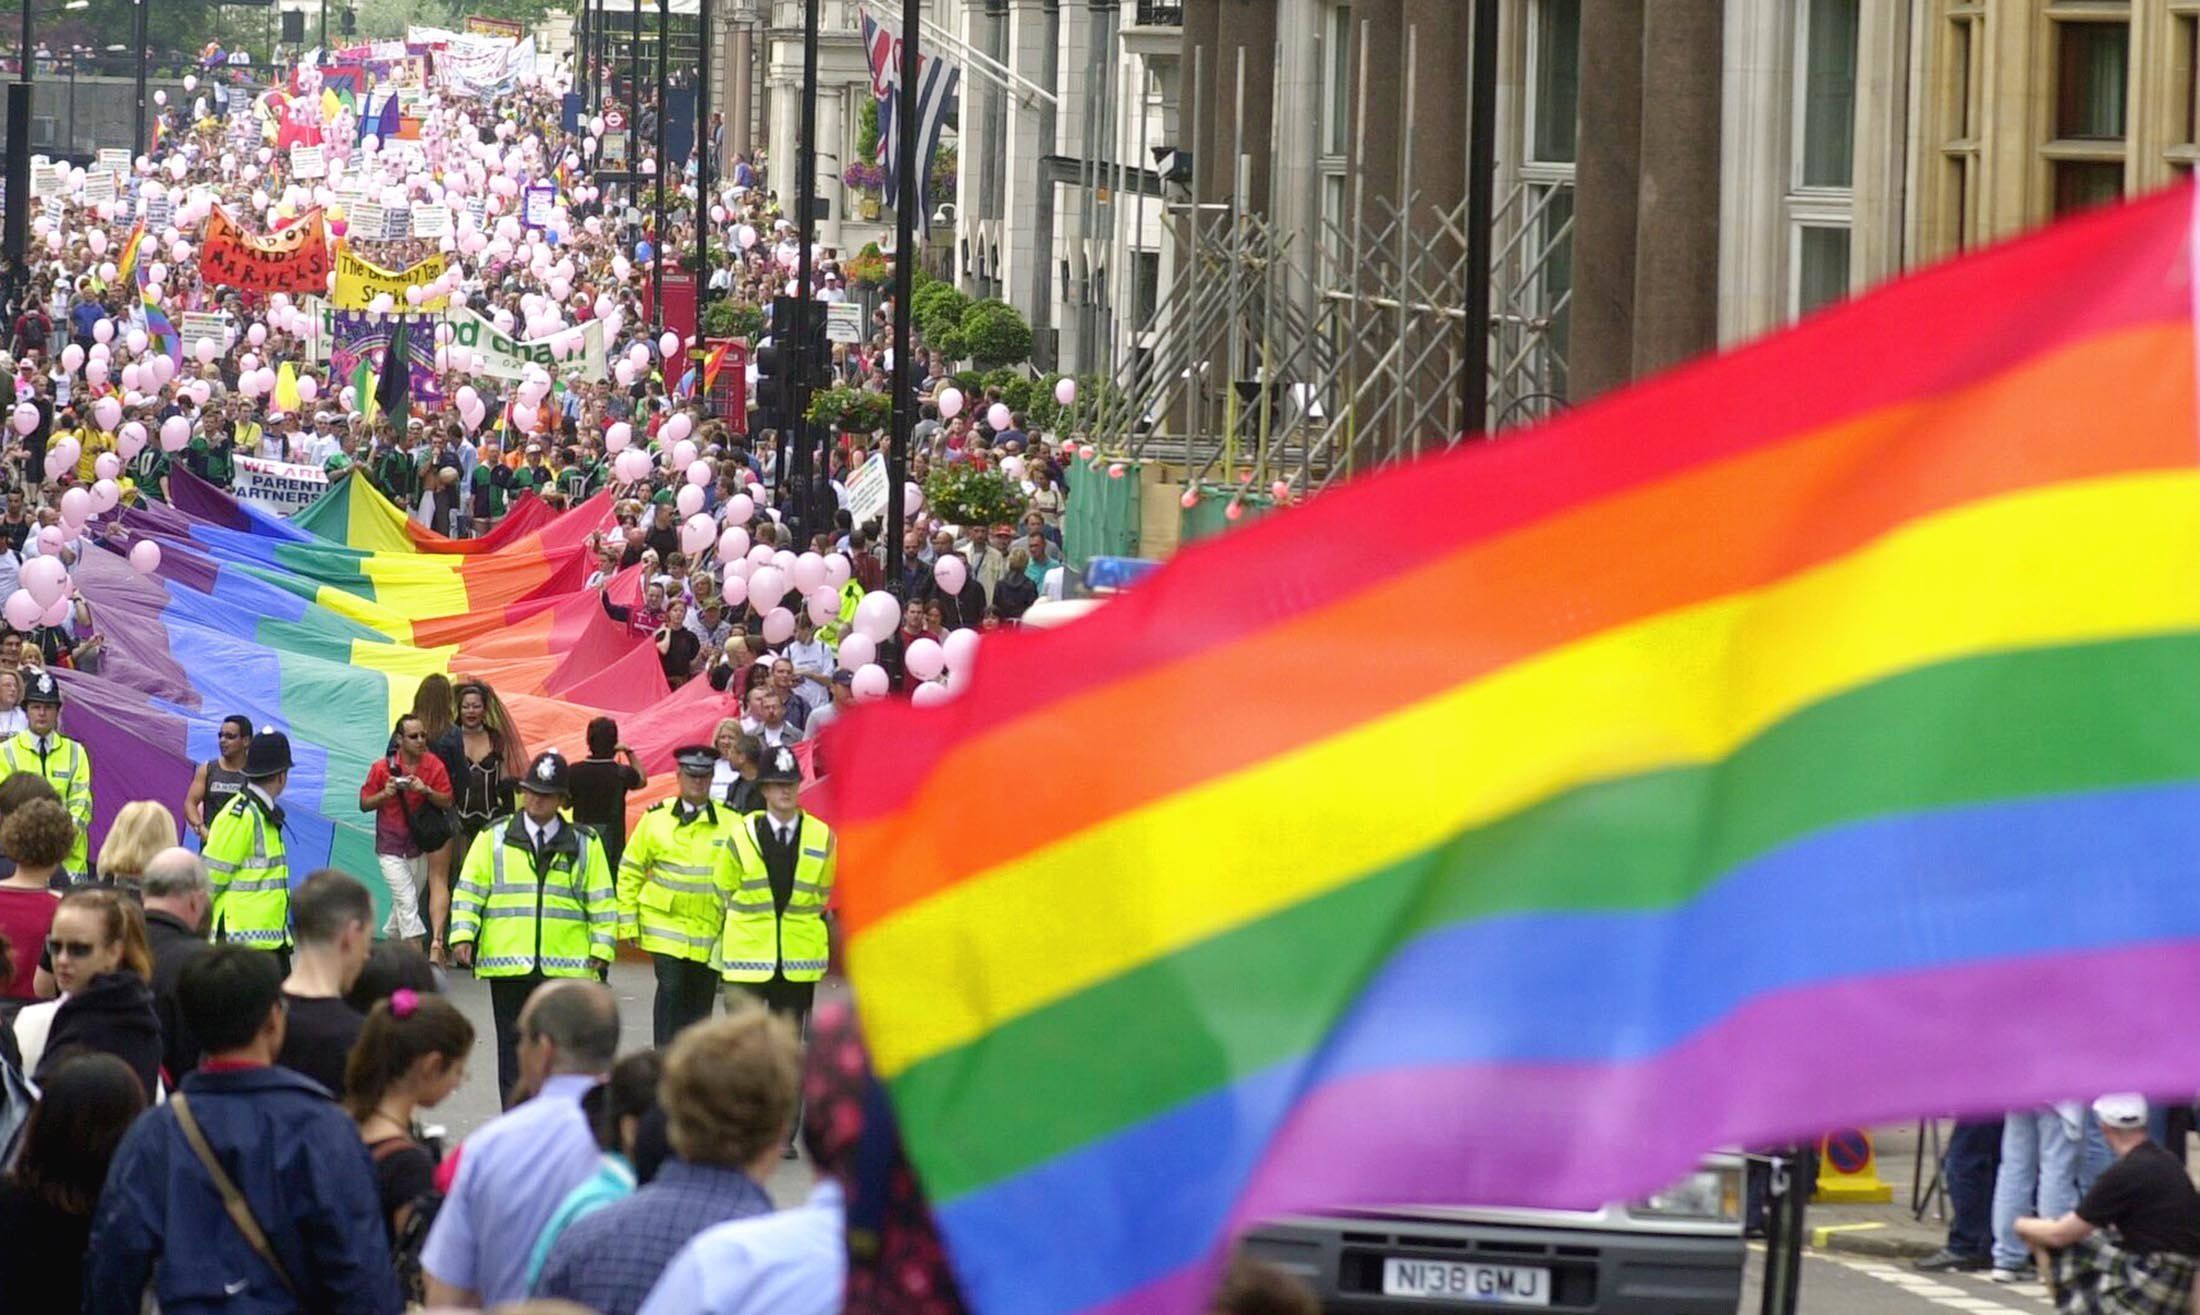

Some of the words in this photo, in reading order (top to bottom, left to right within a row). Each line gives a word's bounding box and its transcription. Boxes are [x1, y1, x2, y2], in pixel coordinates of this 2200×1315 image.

[209, 251, 322, 288] MARVELS
[341, 256, 365, 276] The
[243, 460, 275, 475] WE
[284, 466, 325, 480] ARE
[1397, 1264, 1467, 1293] N138
[1475, 1269, 1537, 1297] GMJ
